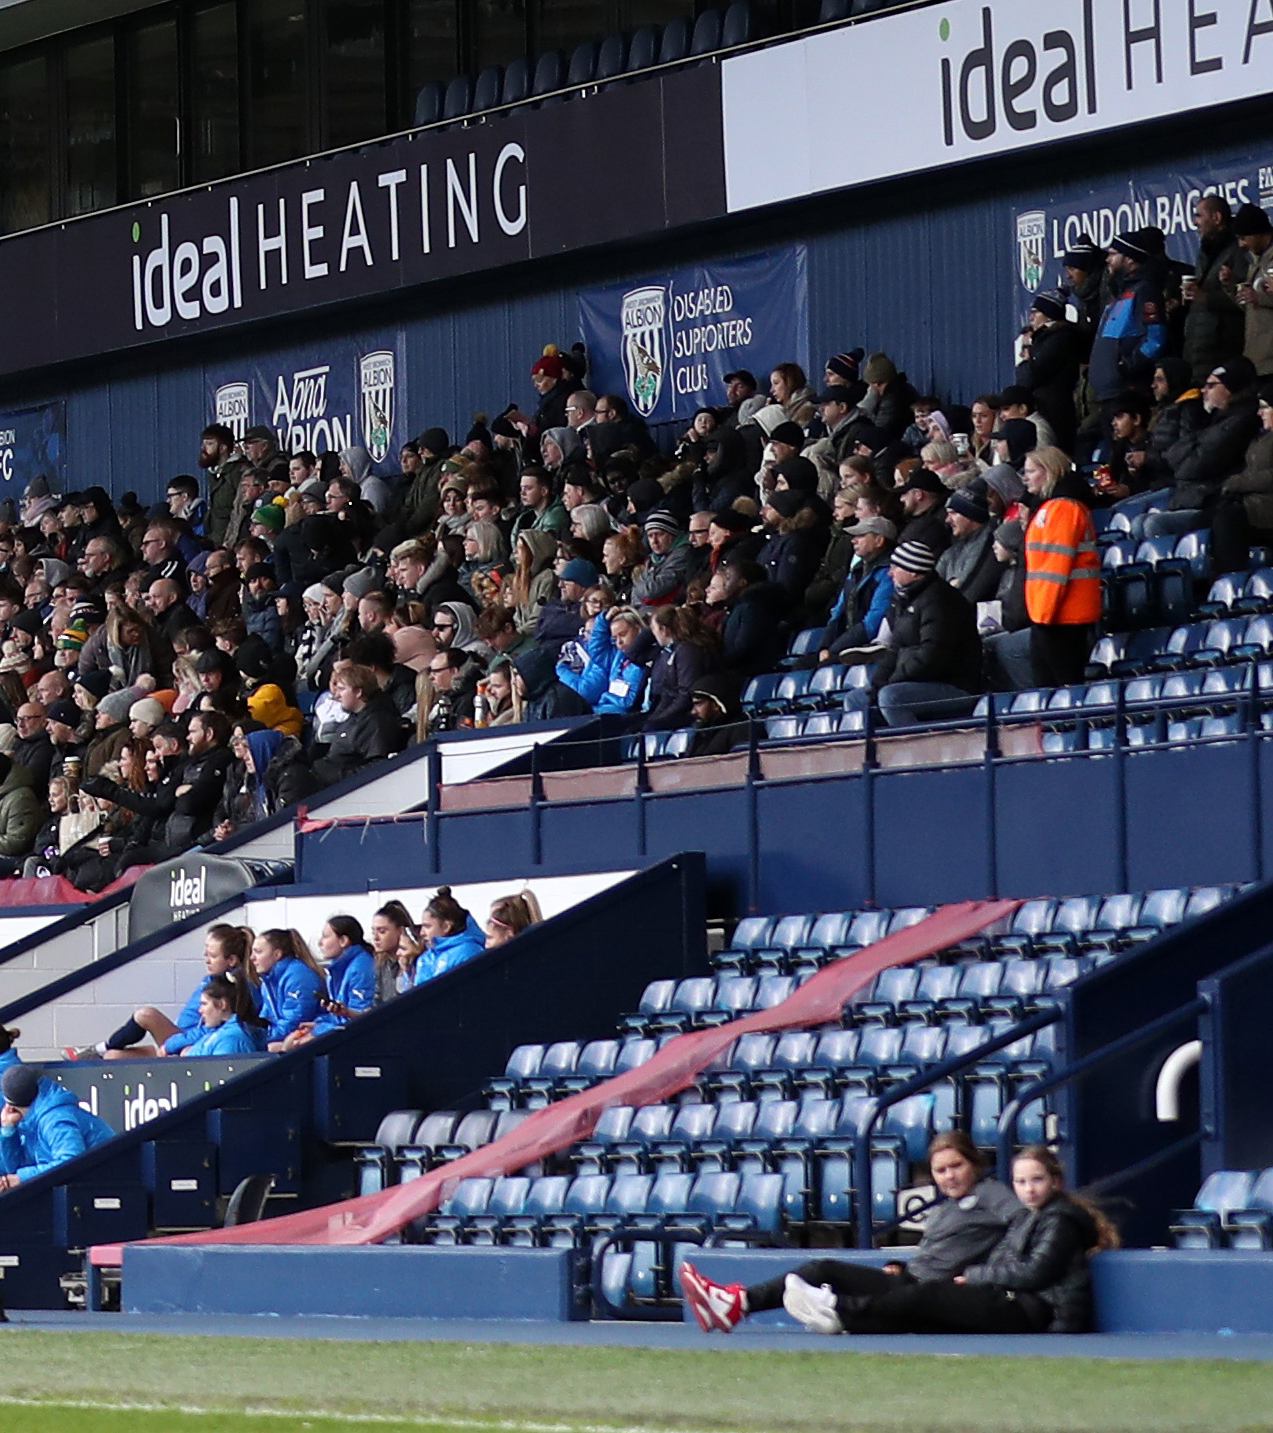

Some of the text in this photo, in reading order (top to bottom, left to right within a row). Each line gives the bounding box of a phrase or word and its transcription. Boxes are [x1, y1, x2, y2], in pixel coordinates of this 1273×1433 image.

[132, 142, 527, 330] ideal HEATING
[1053, 199, 1149, 258] LONDON
[625, 303, 663, 330] ALBION
[674, 285, 733, 322] DISABLED
[674, 317, 753, 358] SUPPORTERS
[362, 367, 393, 388] ALBION
[676, 363, 709, 395] CLUB
[218, 398, 247, 416] ALBION
[170, 865, 206, 908] ideal
